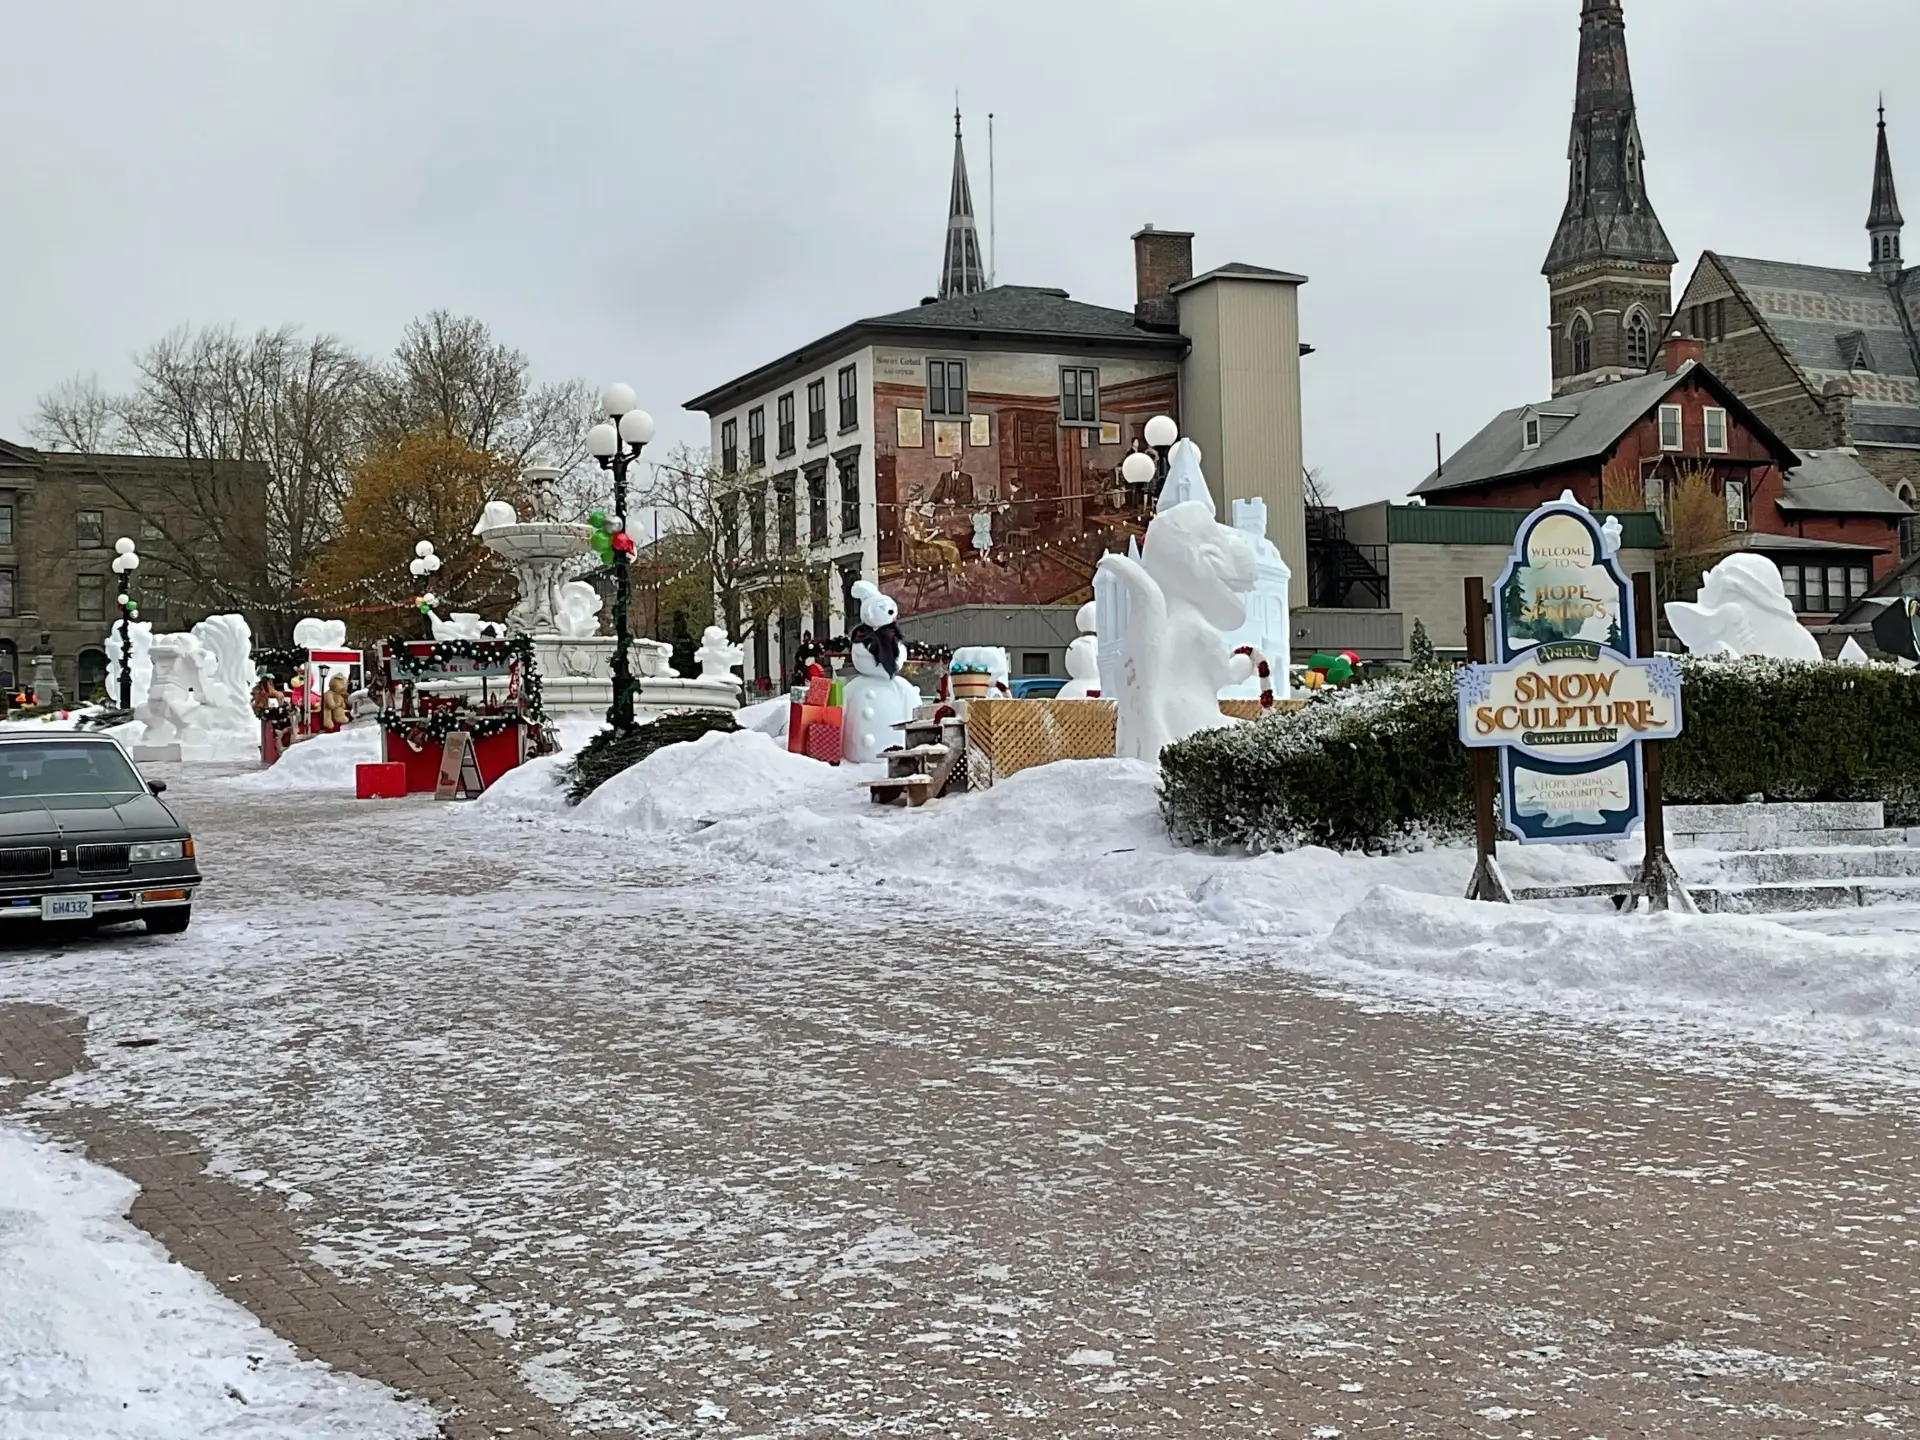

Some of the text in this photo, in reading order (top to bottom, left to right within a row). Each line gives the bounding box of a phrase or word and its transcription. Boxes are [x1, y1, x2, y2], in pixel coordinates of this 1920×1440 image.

[1531, 546, 1591, 557] WELCOME
[1554, 558, 1570, 568] TO
[1534, 584, 1602, 602] HOPE
[1520, 602, 1607, 621] SPRINGS
[1539, 644, 1598, 661] ANNUAL
[1514, 669, 1620, 704] SNOW
[1475, 700, 1668, 734] SCULPTURE
[1523, 728, 1617, 744] COMPETITION
[1540, 779, 1568, 790] HOPE
[1571, 777, 1613, 788] SPRINGS
[1539, 787, 1605, 799] COMMUNITY
[1546, 799, 1603, 810] TRADITION
